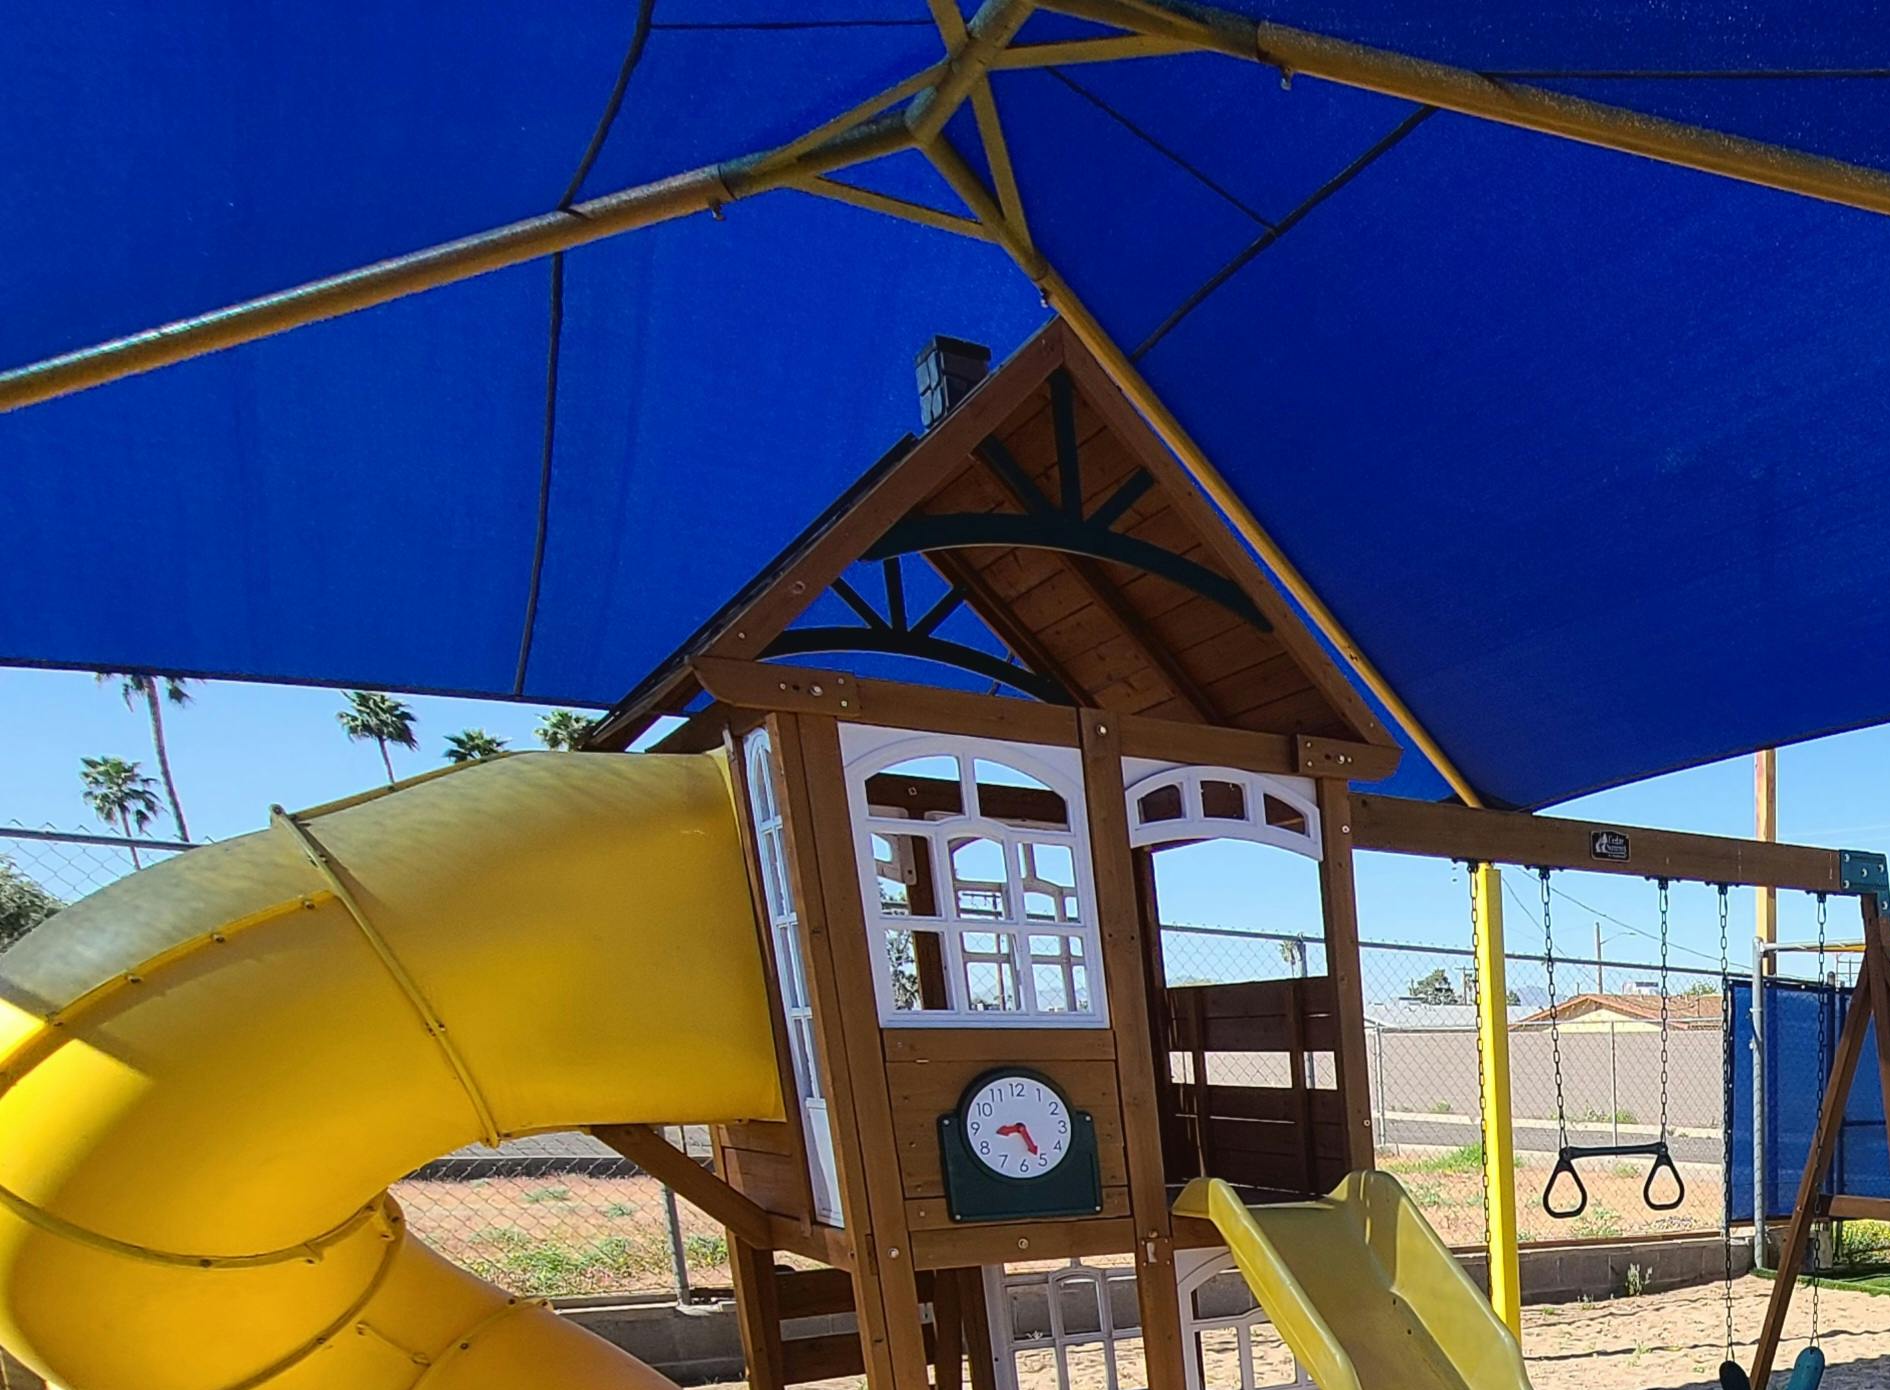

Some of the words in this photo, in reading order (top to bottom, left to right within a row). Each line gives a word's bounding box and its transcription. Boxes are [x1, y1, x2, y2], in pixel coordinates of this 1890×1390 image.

[989, 1088, 1003, 1103] 11
[1008, 1082, 1025, 1097] 12
[1035, 1087, 1042, 1102] 1
[976, 1102, 993, 1117] 10
[1048, 1101, 1060, 1116] 2
[970, 1121, 981, 1137] 9
[1057, 1119, 1068, 1134] 3
[979, 1140, 991, 1156] 8
[1052, 1139, 1063, 1152] 4
[998, 1154, 1009, 1169] 7
[1019, 1158, 1030, 1173] 6
[1037, 1152, 1048, 1167] 5
